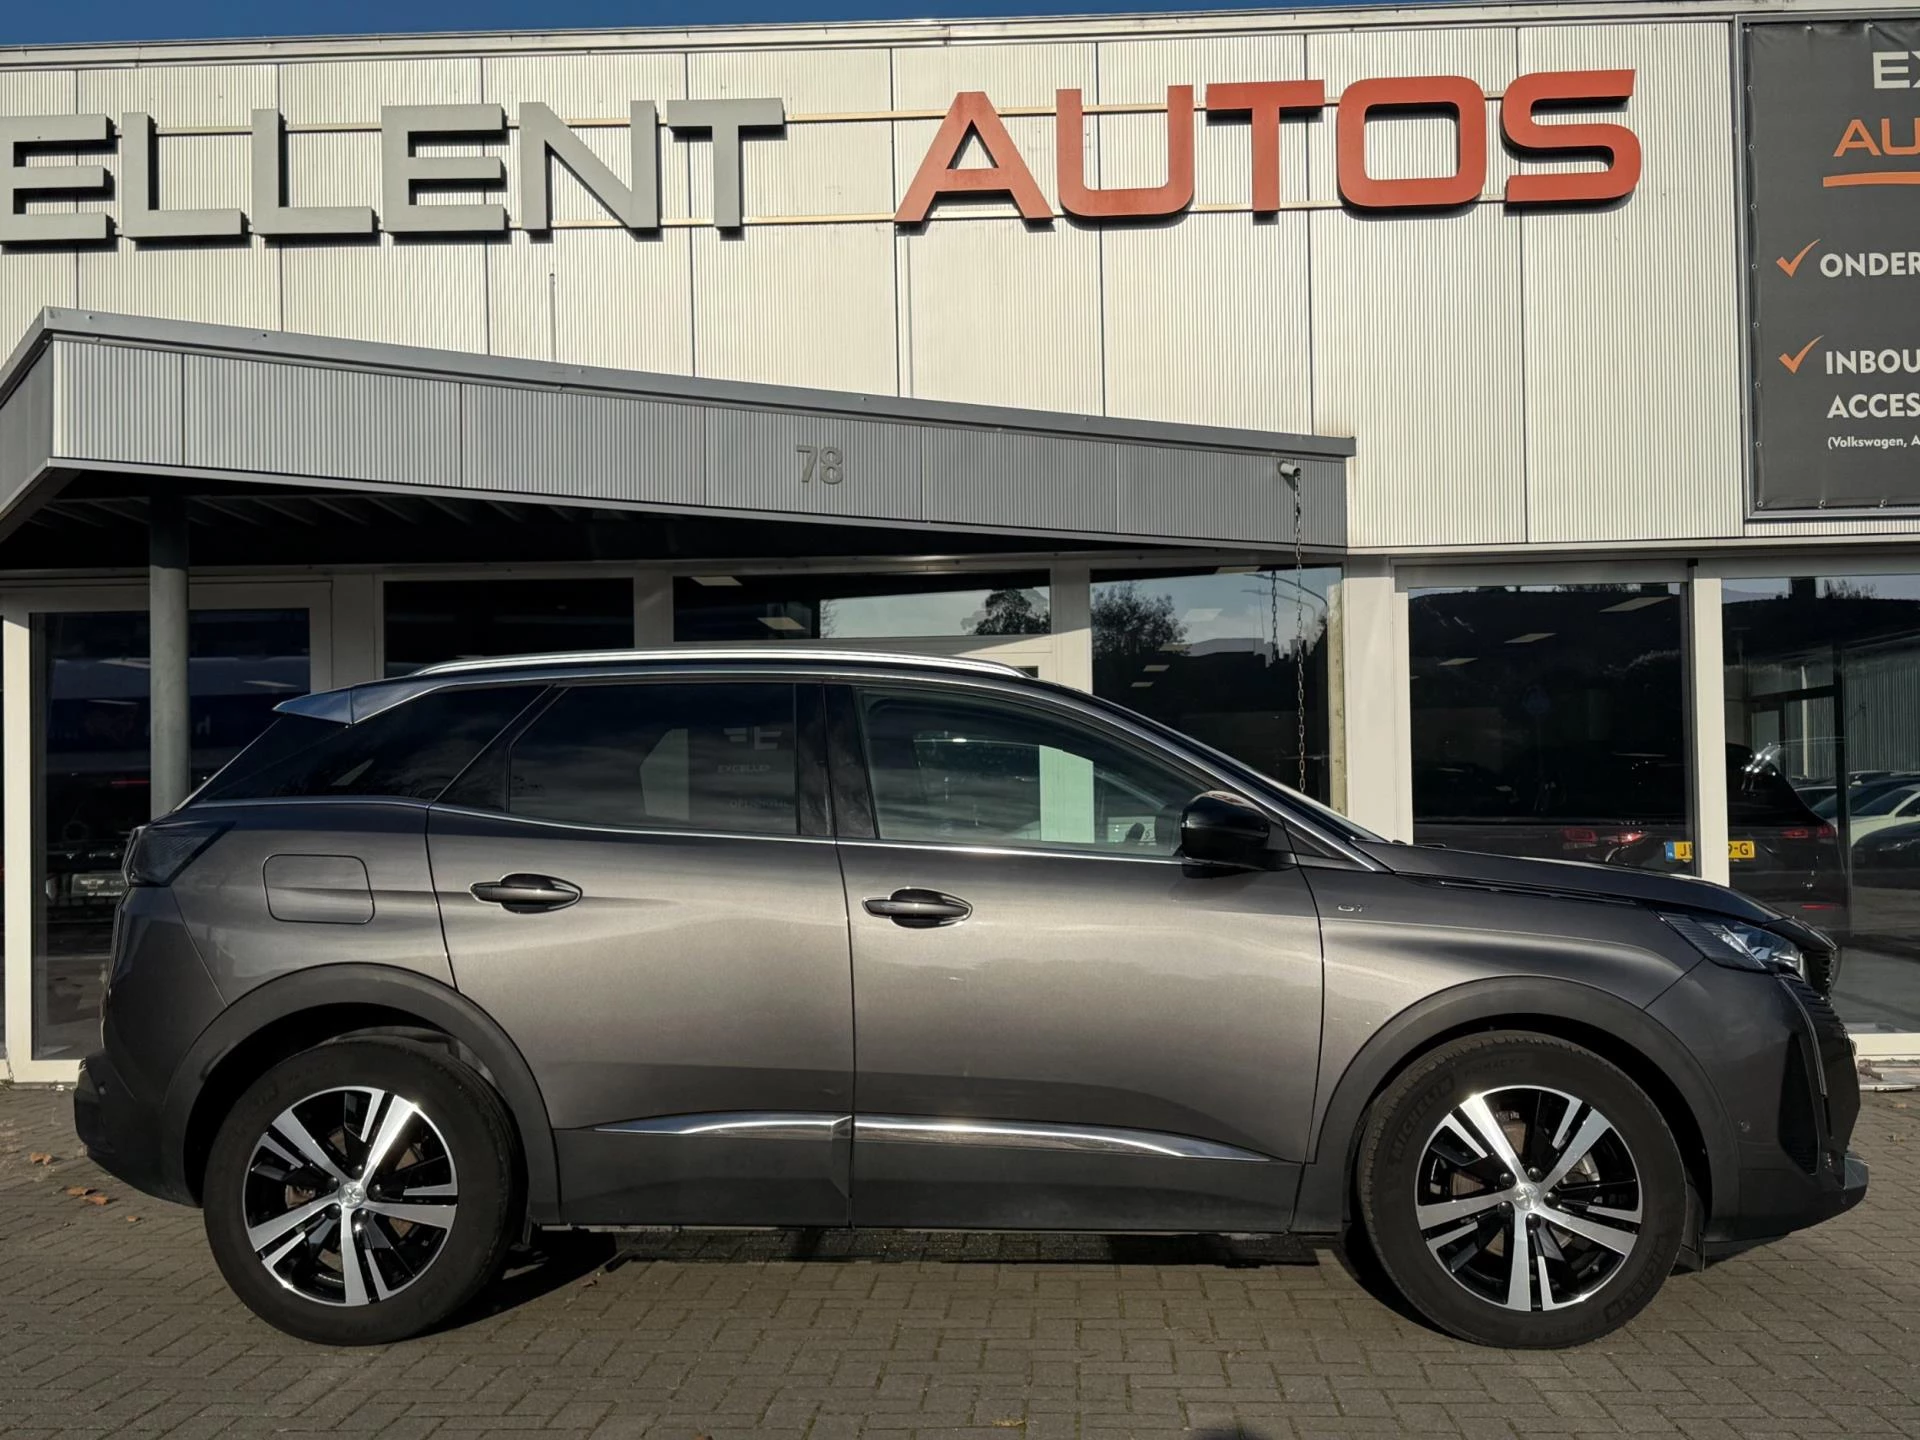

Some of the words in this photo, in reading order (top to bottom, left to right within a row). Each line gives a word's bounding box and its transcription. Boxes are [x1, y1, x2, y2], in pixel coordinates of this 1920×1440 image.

[1873, 51, 1920, 88] E
[1833, 117, 1920, 157] AU
[0, 99, 784, 241] ELLENT
[893, 69, 1642, 222] AUTOS
[1820, 252, 1920, 277] ONDER
[1826, 349, 1920, 374] INBOU
[1827, 393, 1920, 418] ACCES
[1828, 436, 1907, 449] (Volkswagen,
[796, 445, 843, 484] 78
